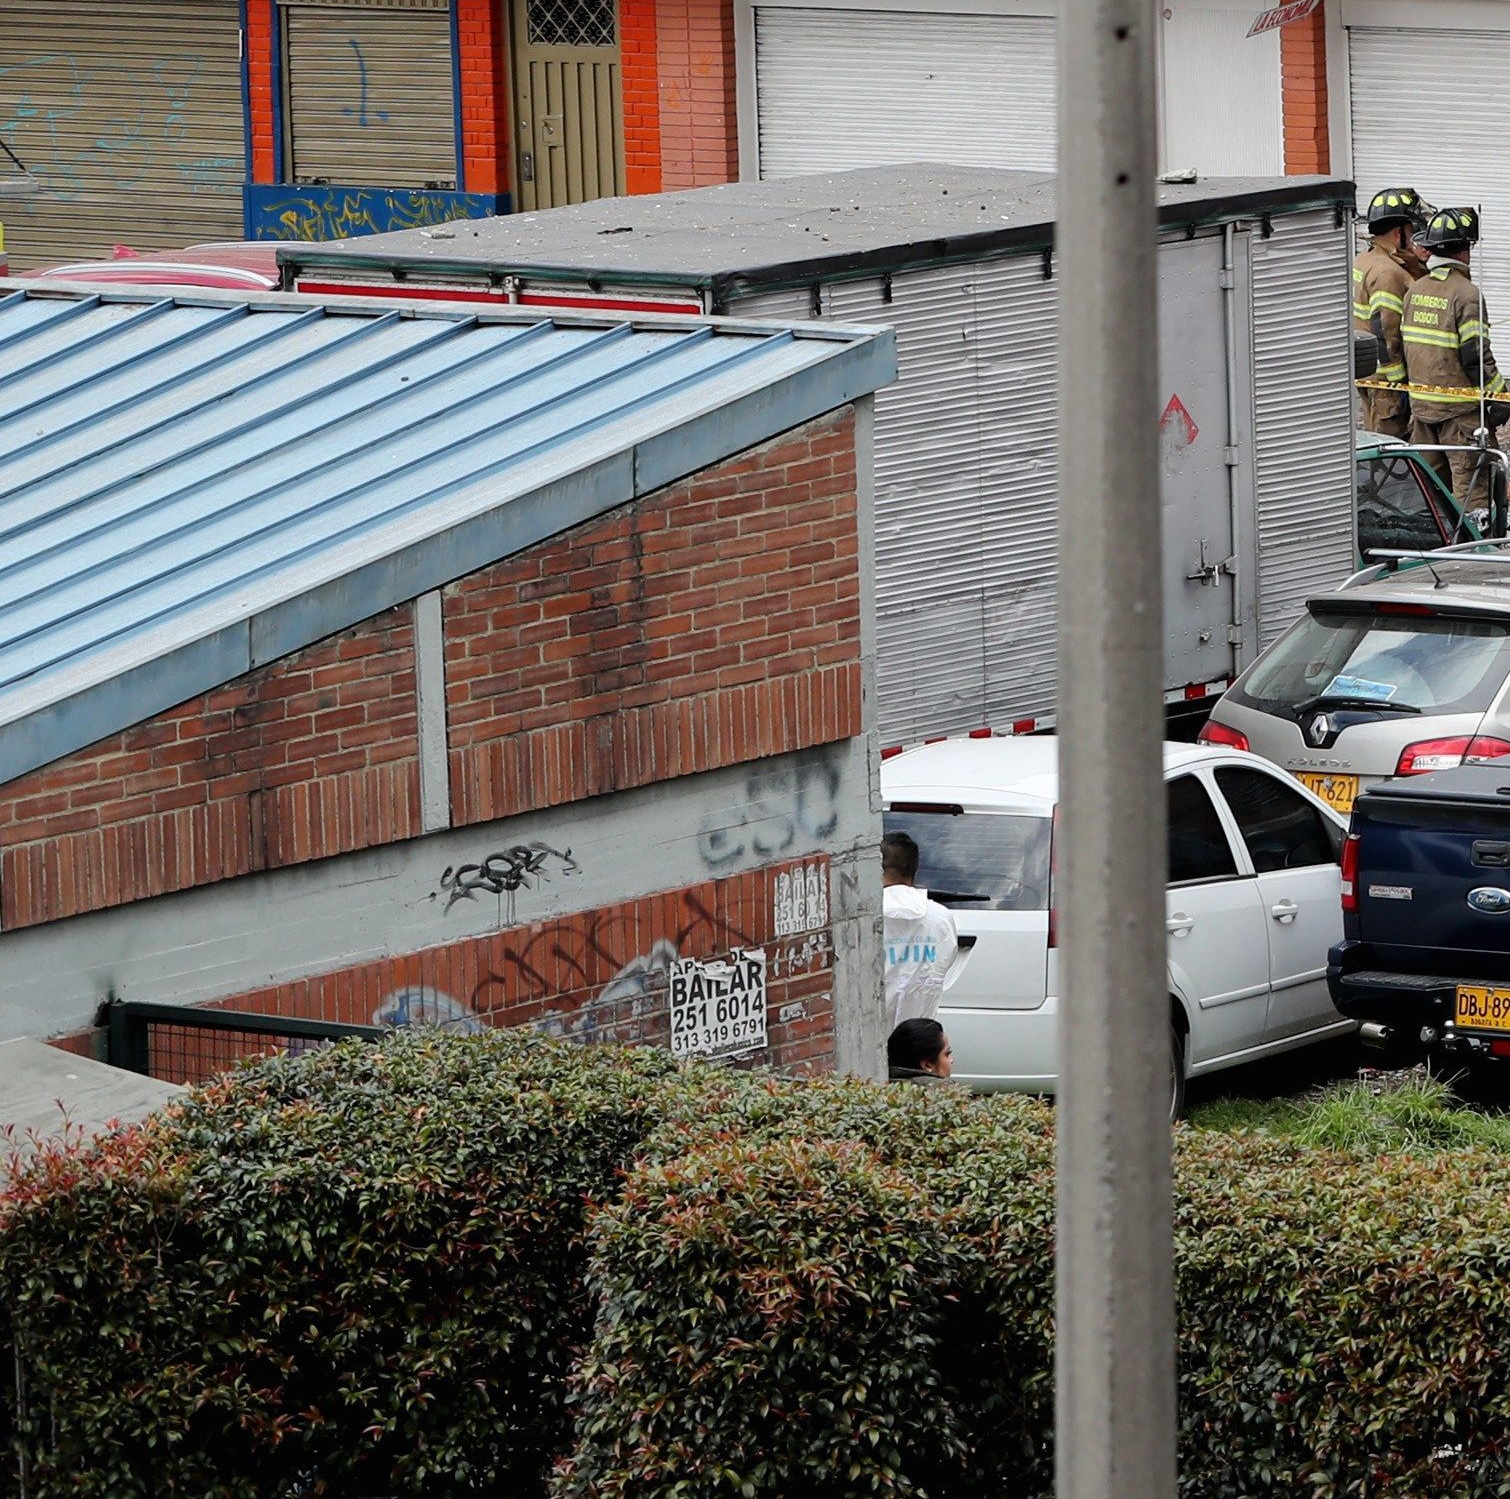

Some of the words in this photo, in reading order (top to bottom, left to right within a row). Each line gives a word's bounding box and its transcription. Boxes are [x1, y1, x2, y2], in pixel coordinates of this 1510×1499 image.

[672, 961, 763, 1008] BAILAR
[673, 1003, 707, 1034] 251
[716, 990, 764, 1023] 6014
[674, 1031, 699, 1052] 313
[703, 1022, 729, 1044] 319
[732, 1016, 765, 1039] 6791
